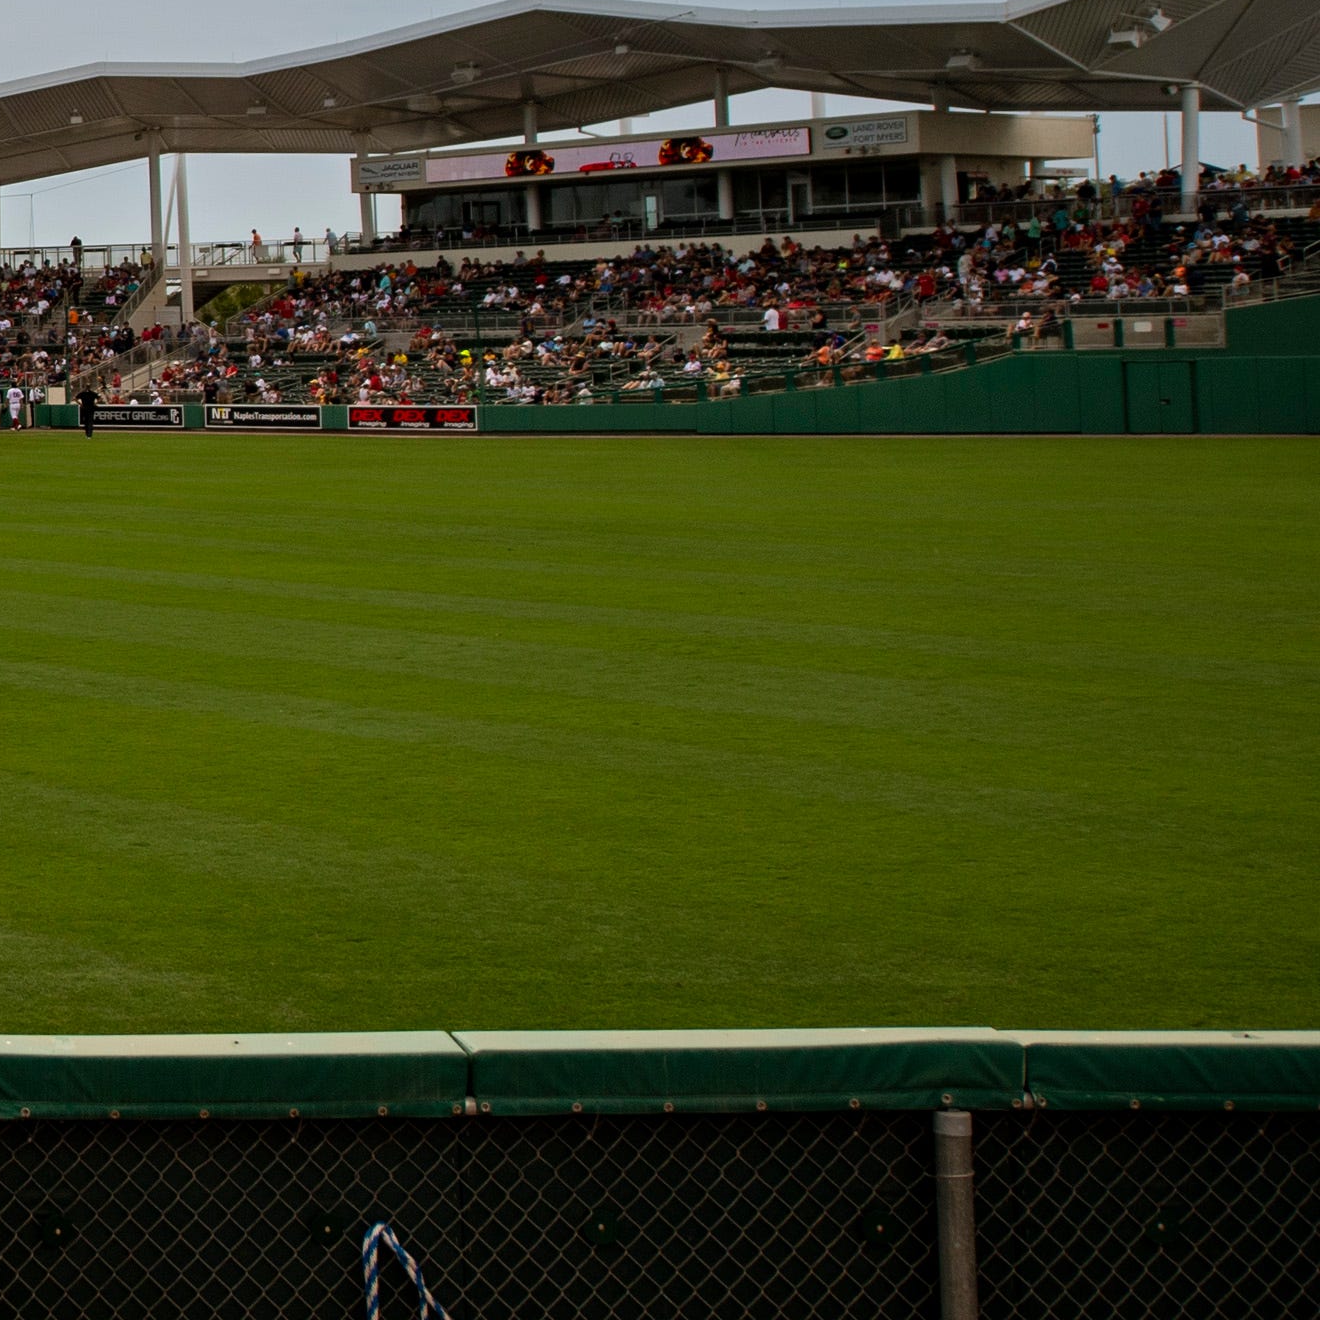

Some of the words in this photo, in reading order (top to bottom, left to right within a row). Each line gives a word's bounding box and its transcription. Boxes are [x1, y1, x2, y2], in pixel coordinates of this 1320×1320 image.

[852, 123, 875, 133] LAND
[876, 120, 904, 130] ROVER
[853, 134, 875, 143] FORT
[381, 162, 418, 171] JAGUAR
[93, 411, 130, 421] PERFECT
[234, 412, 317, 421] NaplesTransportation.com
[351, 409, 383, 422] DEX
[393, 409, 426, 422] DEX
[436, 409, 470, 422] DEX
